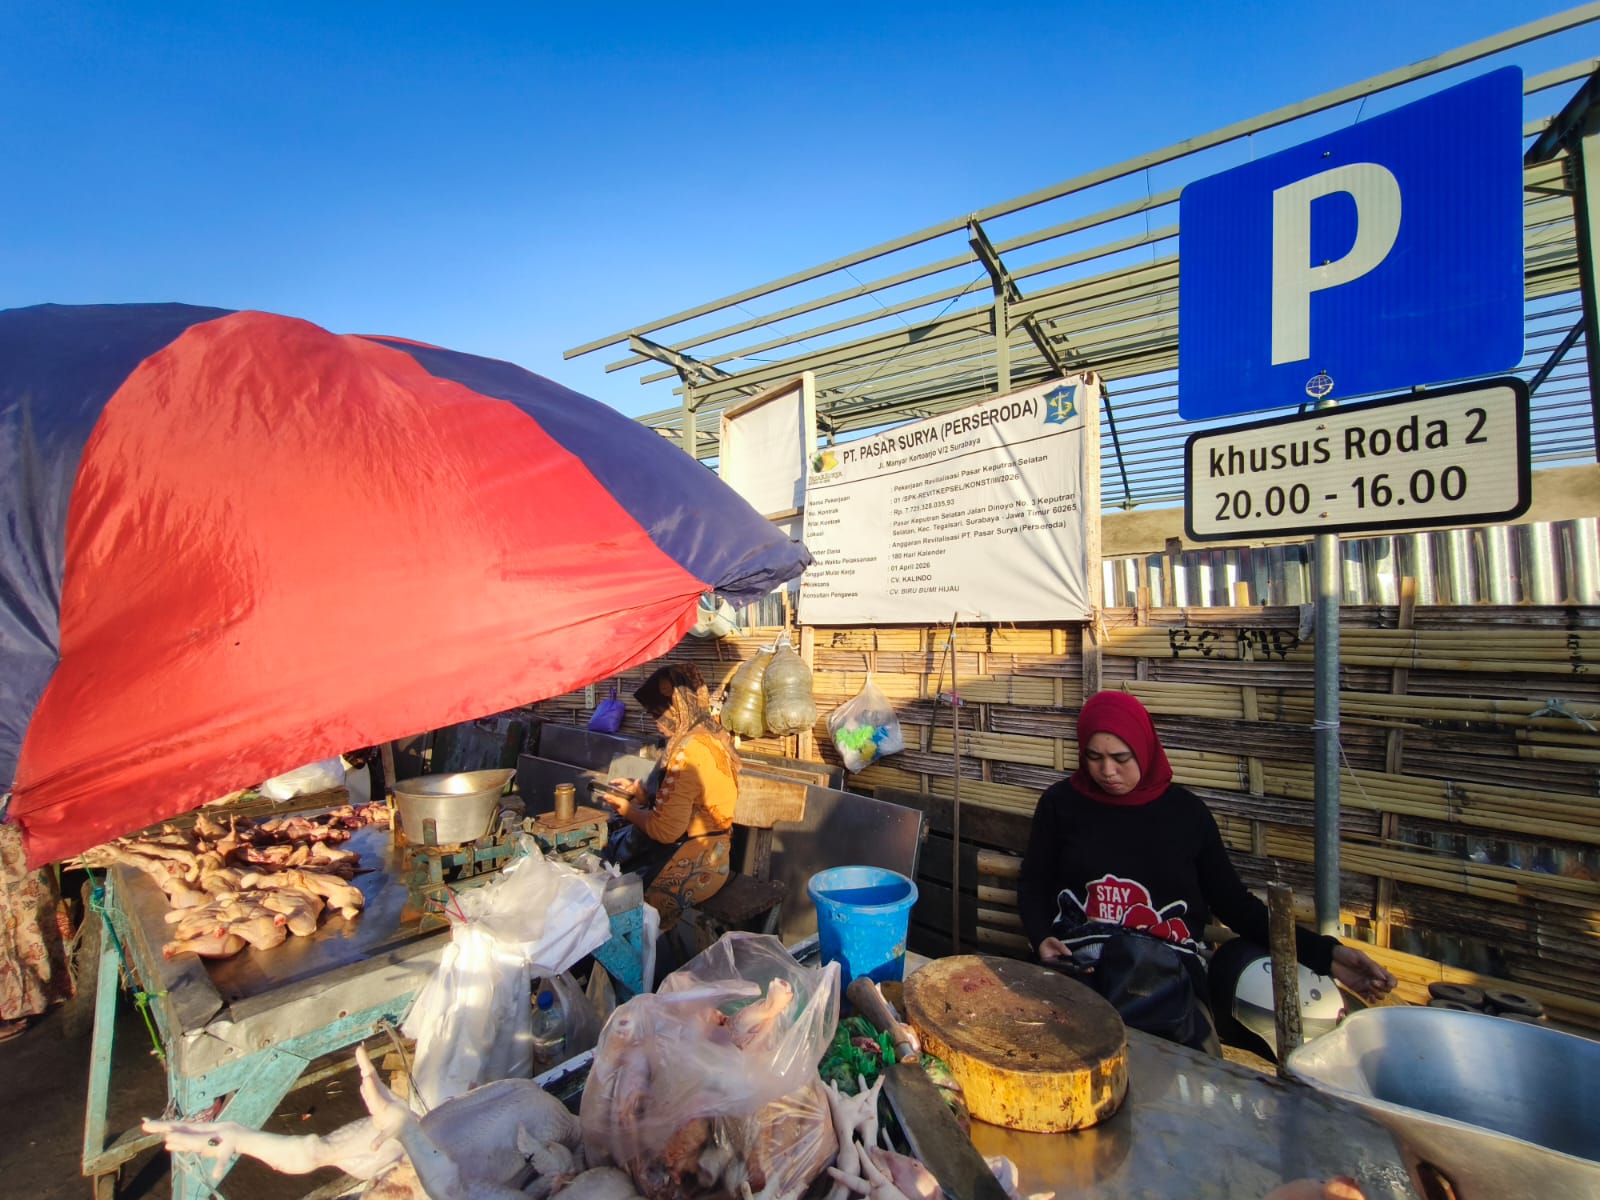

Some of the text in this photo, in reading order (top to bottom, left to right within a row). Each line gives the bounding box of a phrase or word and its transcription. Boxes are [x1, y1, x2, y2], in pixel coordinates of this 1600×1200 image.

[1272, 162, 1402, 366] P
[843, 398, 1038, 464] PT. PASAR SURYA (PERSERODA)
[1209, 407, 1488, 478] khusus Roda 2
[886, 456, 908, 468] Manyar
[950, 437, 981, 452] Surabaya
[894, 455, 1048, 492] Pekerjaan Revitalisasi Pasar Keputran Selatan
[941, 510, 965, 519] Selatan
[967, 507, 986, 515] Jalan
[987, 503, 1014, 512] Dinoyo
[1037, 493, 1075, 504] Keputran
[1215, 483, 1310, 521] 20.00
[1351, 465, 1467, 508] 16.00
[965, 516, 1000, 526] Surabaya
[1005, 511, 1025, 520] Jawa
[1052, 504, 1077, 514] 60265
[892, 540, 921, 548] Anggaran
[922, 535, 960, 544] Revitalisasi
[973, 530, 994, 538] Pasar
[996, 526, 1018, 535] Surya
[1019, 520, 1066, 532] (Perseroda)
[917, 548, 946, 557] Kalender
[899, 563, 914, 571] April
[902, 574, 932, 582] KALINDO
[901, 587, 917, 595] BIRU
[938, 585, 960, 593] HIJAU
[1096, 884, 1131, 904] STAY
